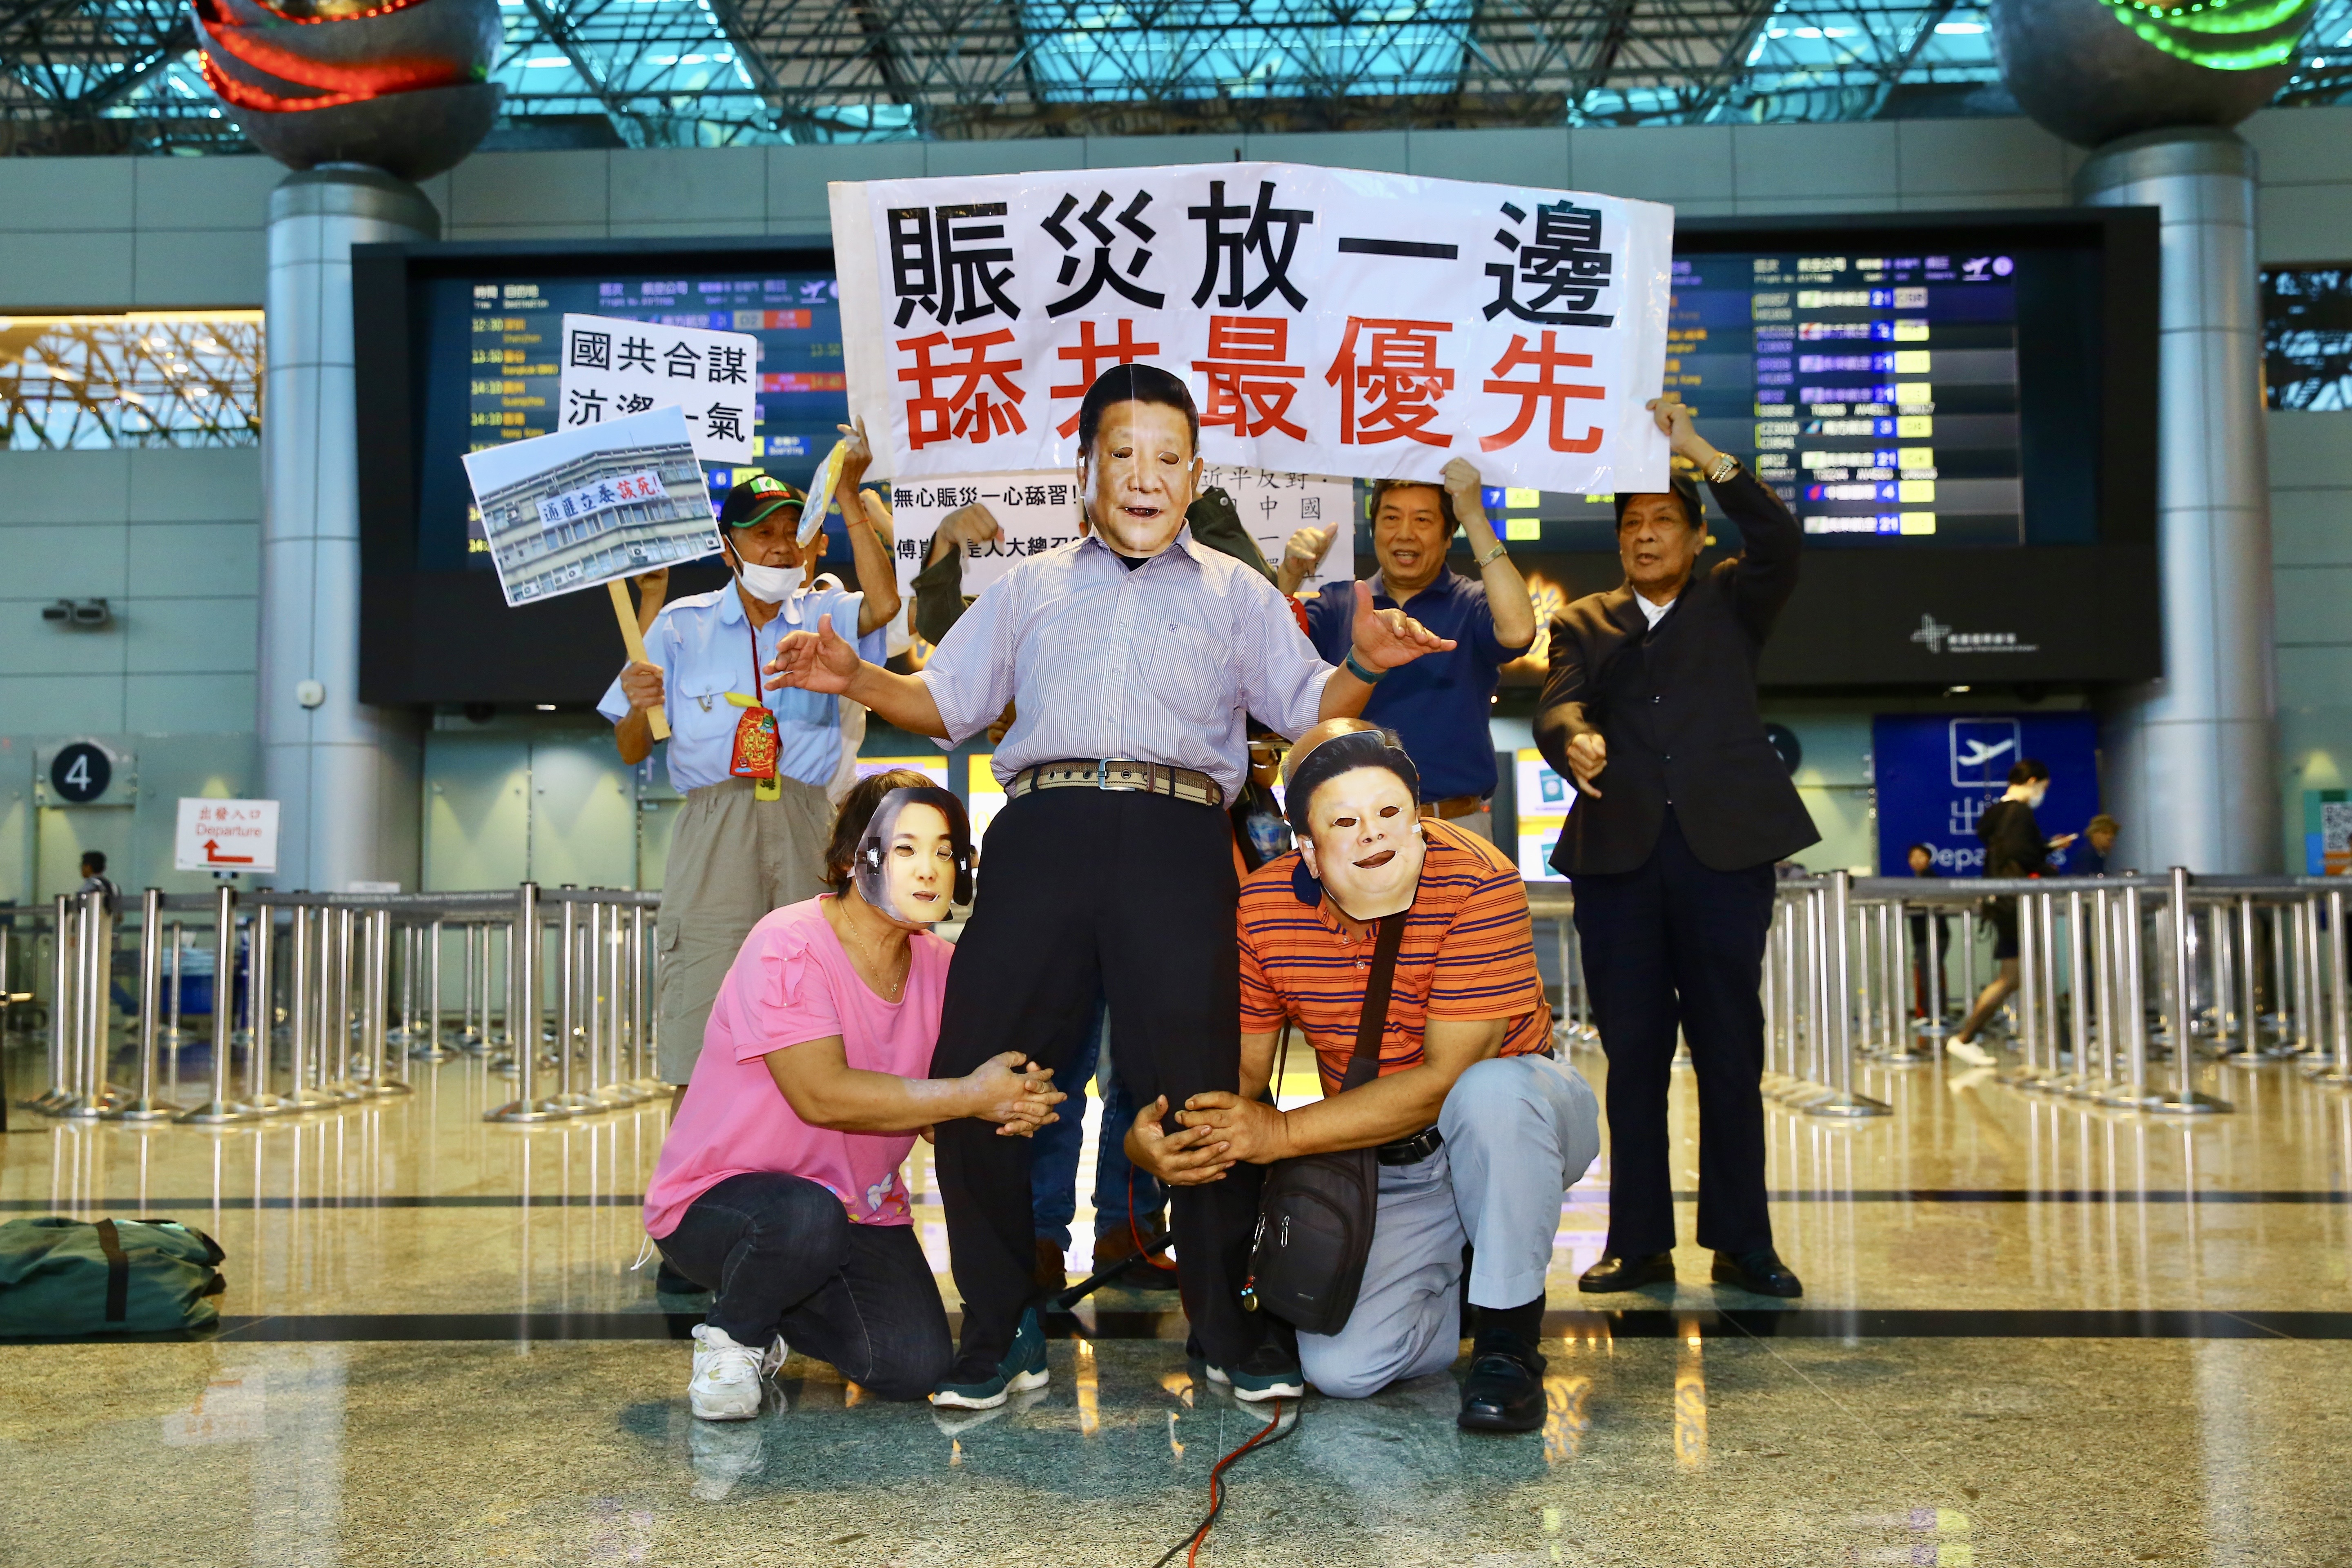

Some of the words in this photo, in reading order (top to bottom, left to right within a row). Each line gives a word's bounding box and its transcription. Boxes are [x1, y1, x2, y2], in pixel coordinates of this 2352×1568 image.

[887, 181, 1615, 328] 賑災放一邊
[571, 330, 747, 384] 國共合謀
[896, 316, 1605, 453] 舔共最優先
[1877, 452, 1897, 466] 21
[543, 476, 660, 522] 通匪立委該死！
[894, 484, 1077, 508] 無心賑災一心舔習！
[1882, 485, 1895, 499] 4
[1879, 517, 1898, 532] 21
[65, 754, 92, 792] 4
[199, 806, 261, 821] 出發入口
[196, 823, 262, 837] Departure
